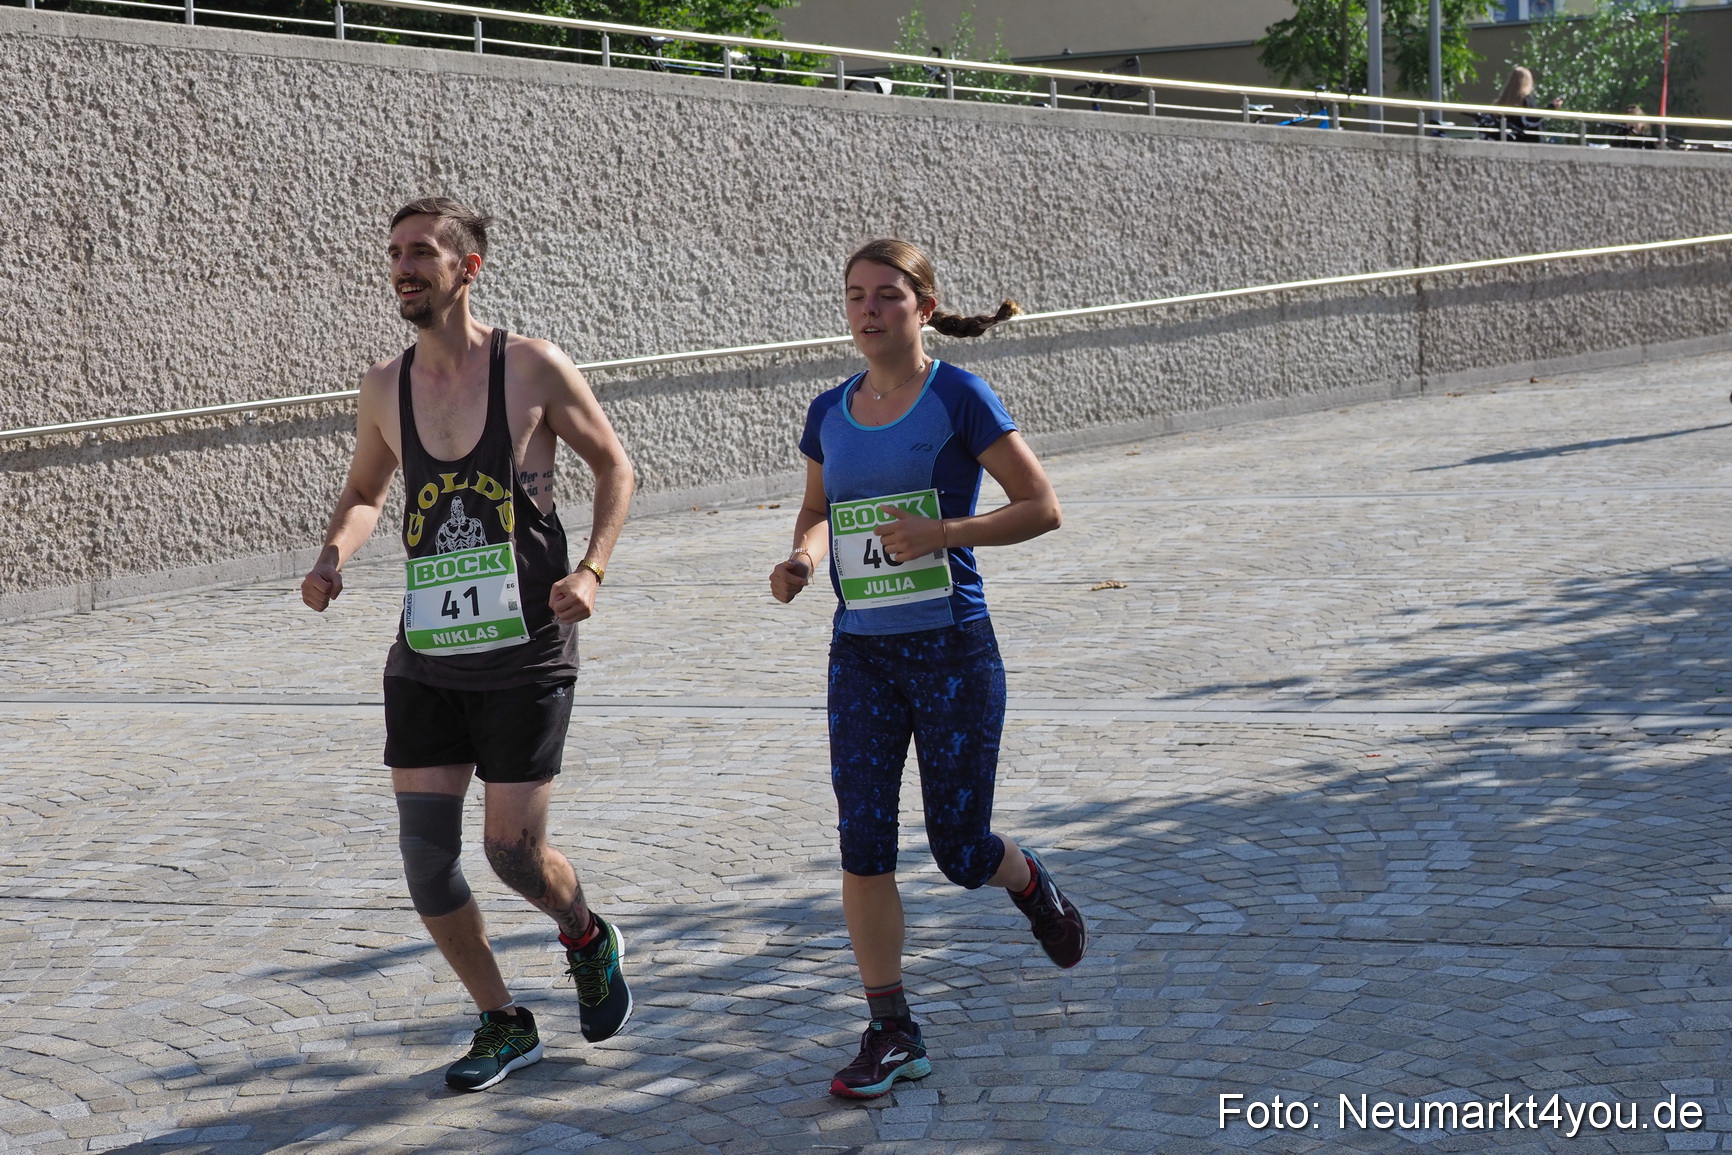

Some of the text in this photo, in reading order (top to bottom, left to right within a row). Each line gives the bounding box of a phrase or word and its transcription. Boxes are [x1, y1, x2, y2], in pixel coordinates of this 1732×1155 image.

[407, 470, 515, 547] GOLD'S
[416, 549, 505, 586] BOCK
[441, 586, 480, 620] 41
[863, 576, 916, 596] JULIA
[432, 625, 499, 646] NIKLAS
